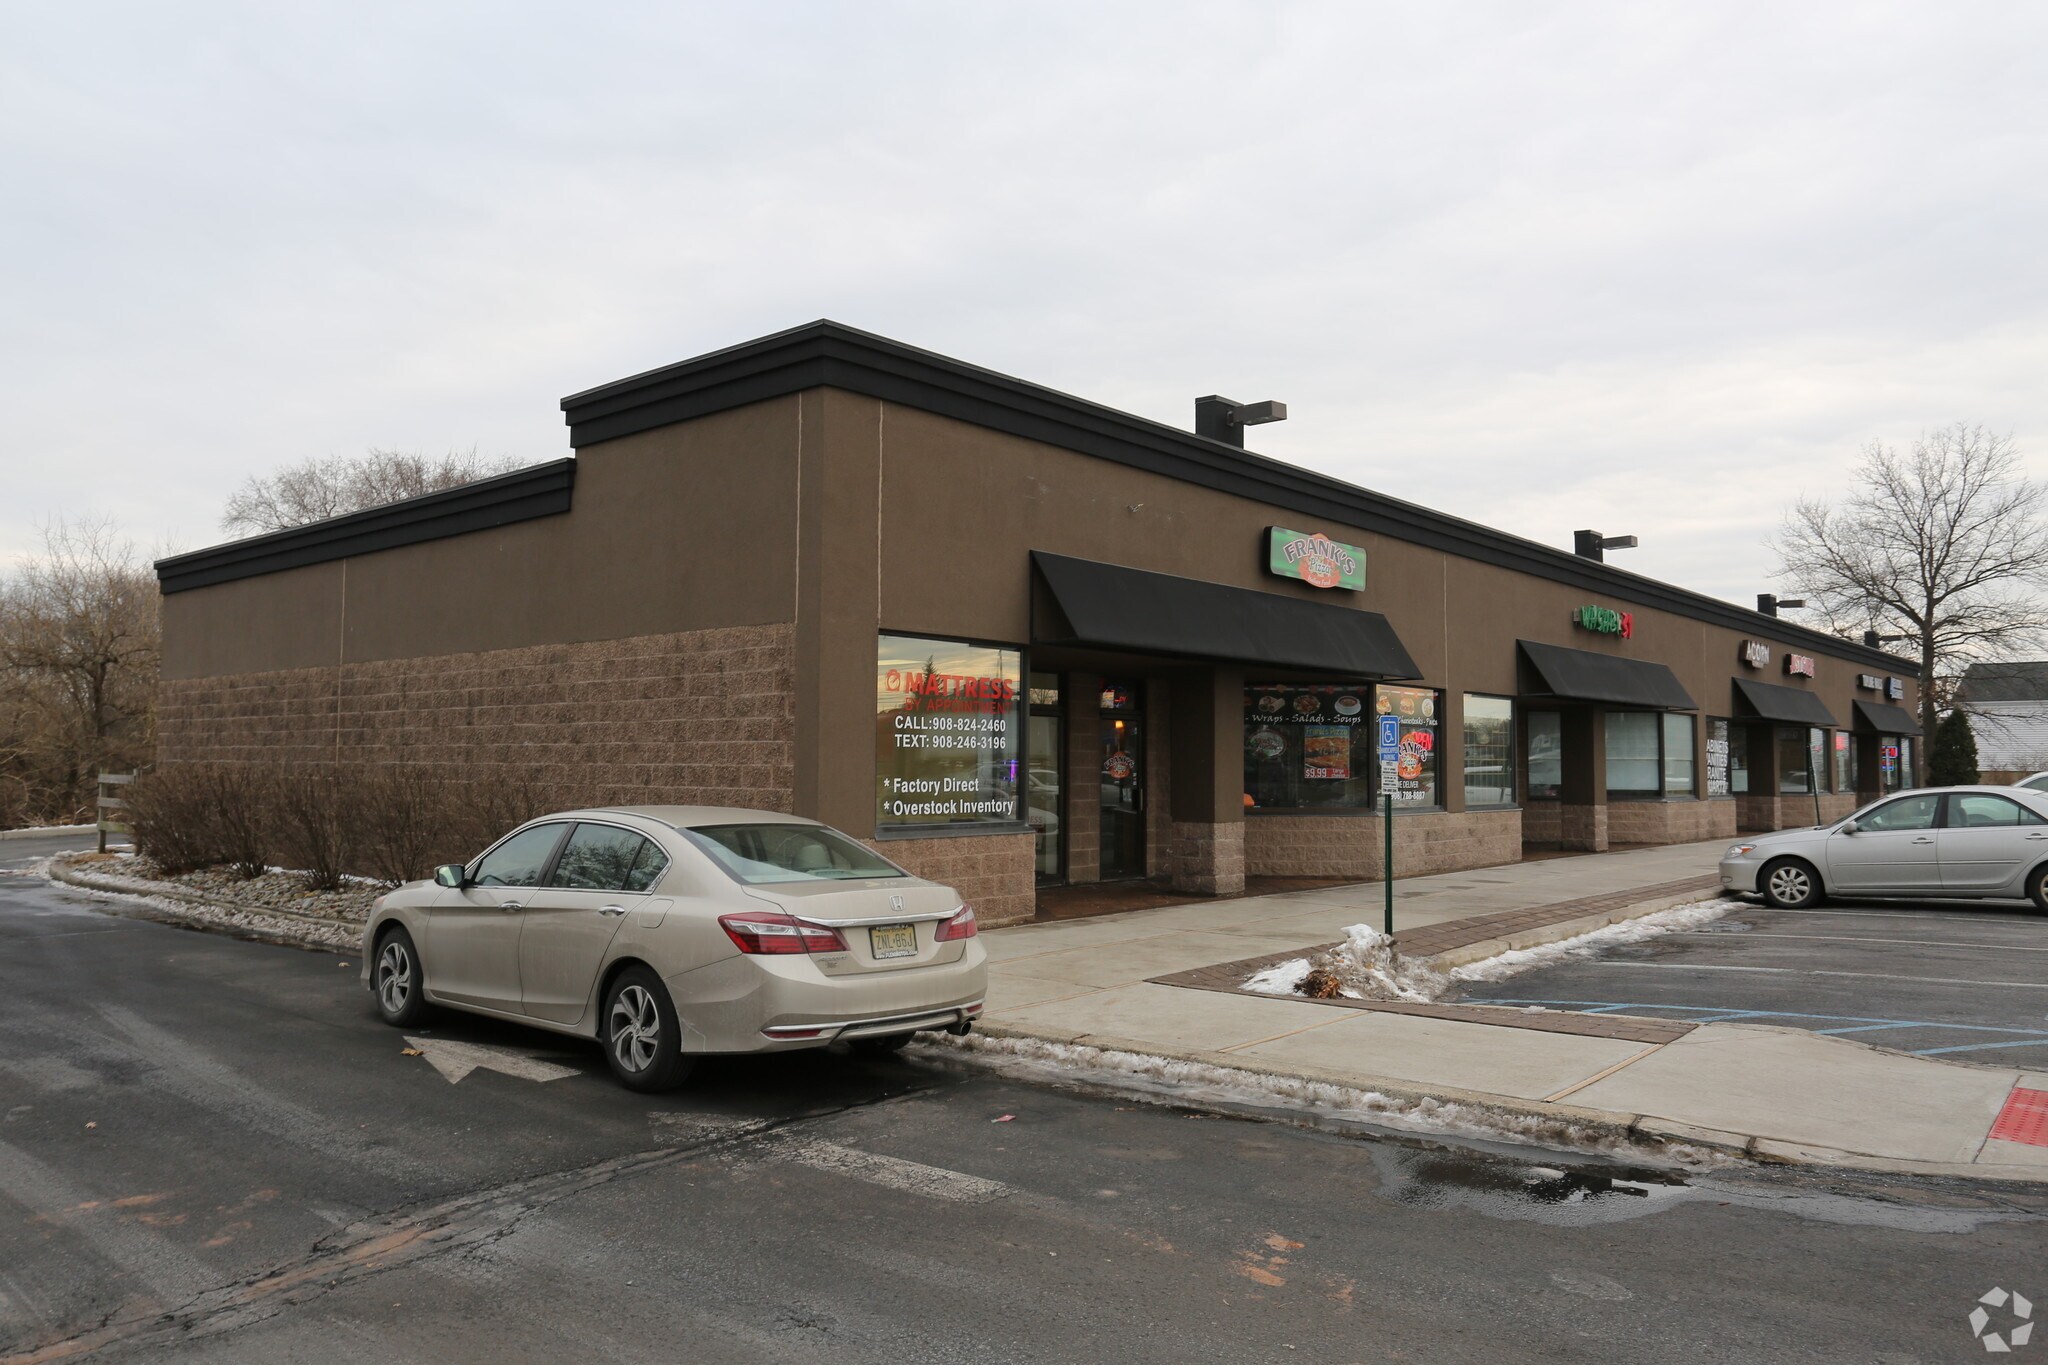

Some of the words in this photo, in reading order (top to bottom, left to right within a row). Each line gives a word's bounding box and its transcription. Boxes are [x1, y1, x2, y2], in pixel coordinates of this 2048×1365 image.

[1283, 538, 1355, 575] FRANK'S
[905, 672, 1015, 699] MATTRESS
[905, 697, 921, 711] BY
[927, 699, 1013, 715] APPOINTMENT
[1252, 714, 1283, 725] Wraps
[1291, 714, 1325, 725] Salads
[1333, 715, 1361, 726] Soups
[895, 734, 929, 748] TEXT:
[932, 735, 1006, 749] 908-246-3196
[1706, 739, 1728, 753] ABINETS
[1398, 740, 1427, 762] RANK'S
[1305, 768, 1327, 778] $9.99
[1707, 766, 1726, 780] RANITE
[893, 778, 940, 795] Factory
[943, 777, 979, 792] Direct
[893, 800, 957, 816] Overstock
[960, 799, 1014, 815] Inventory
